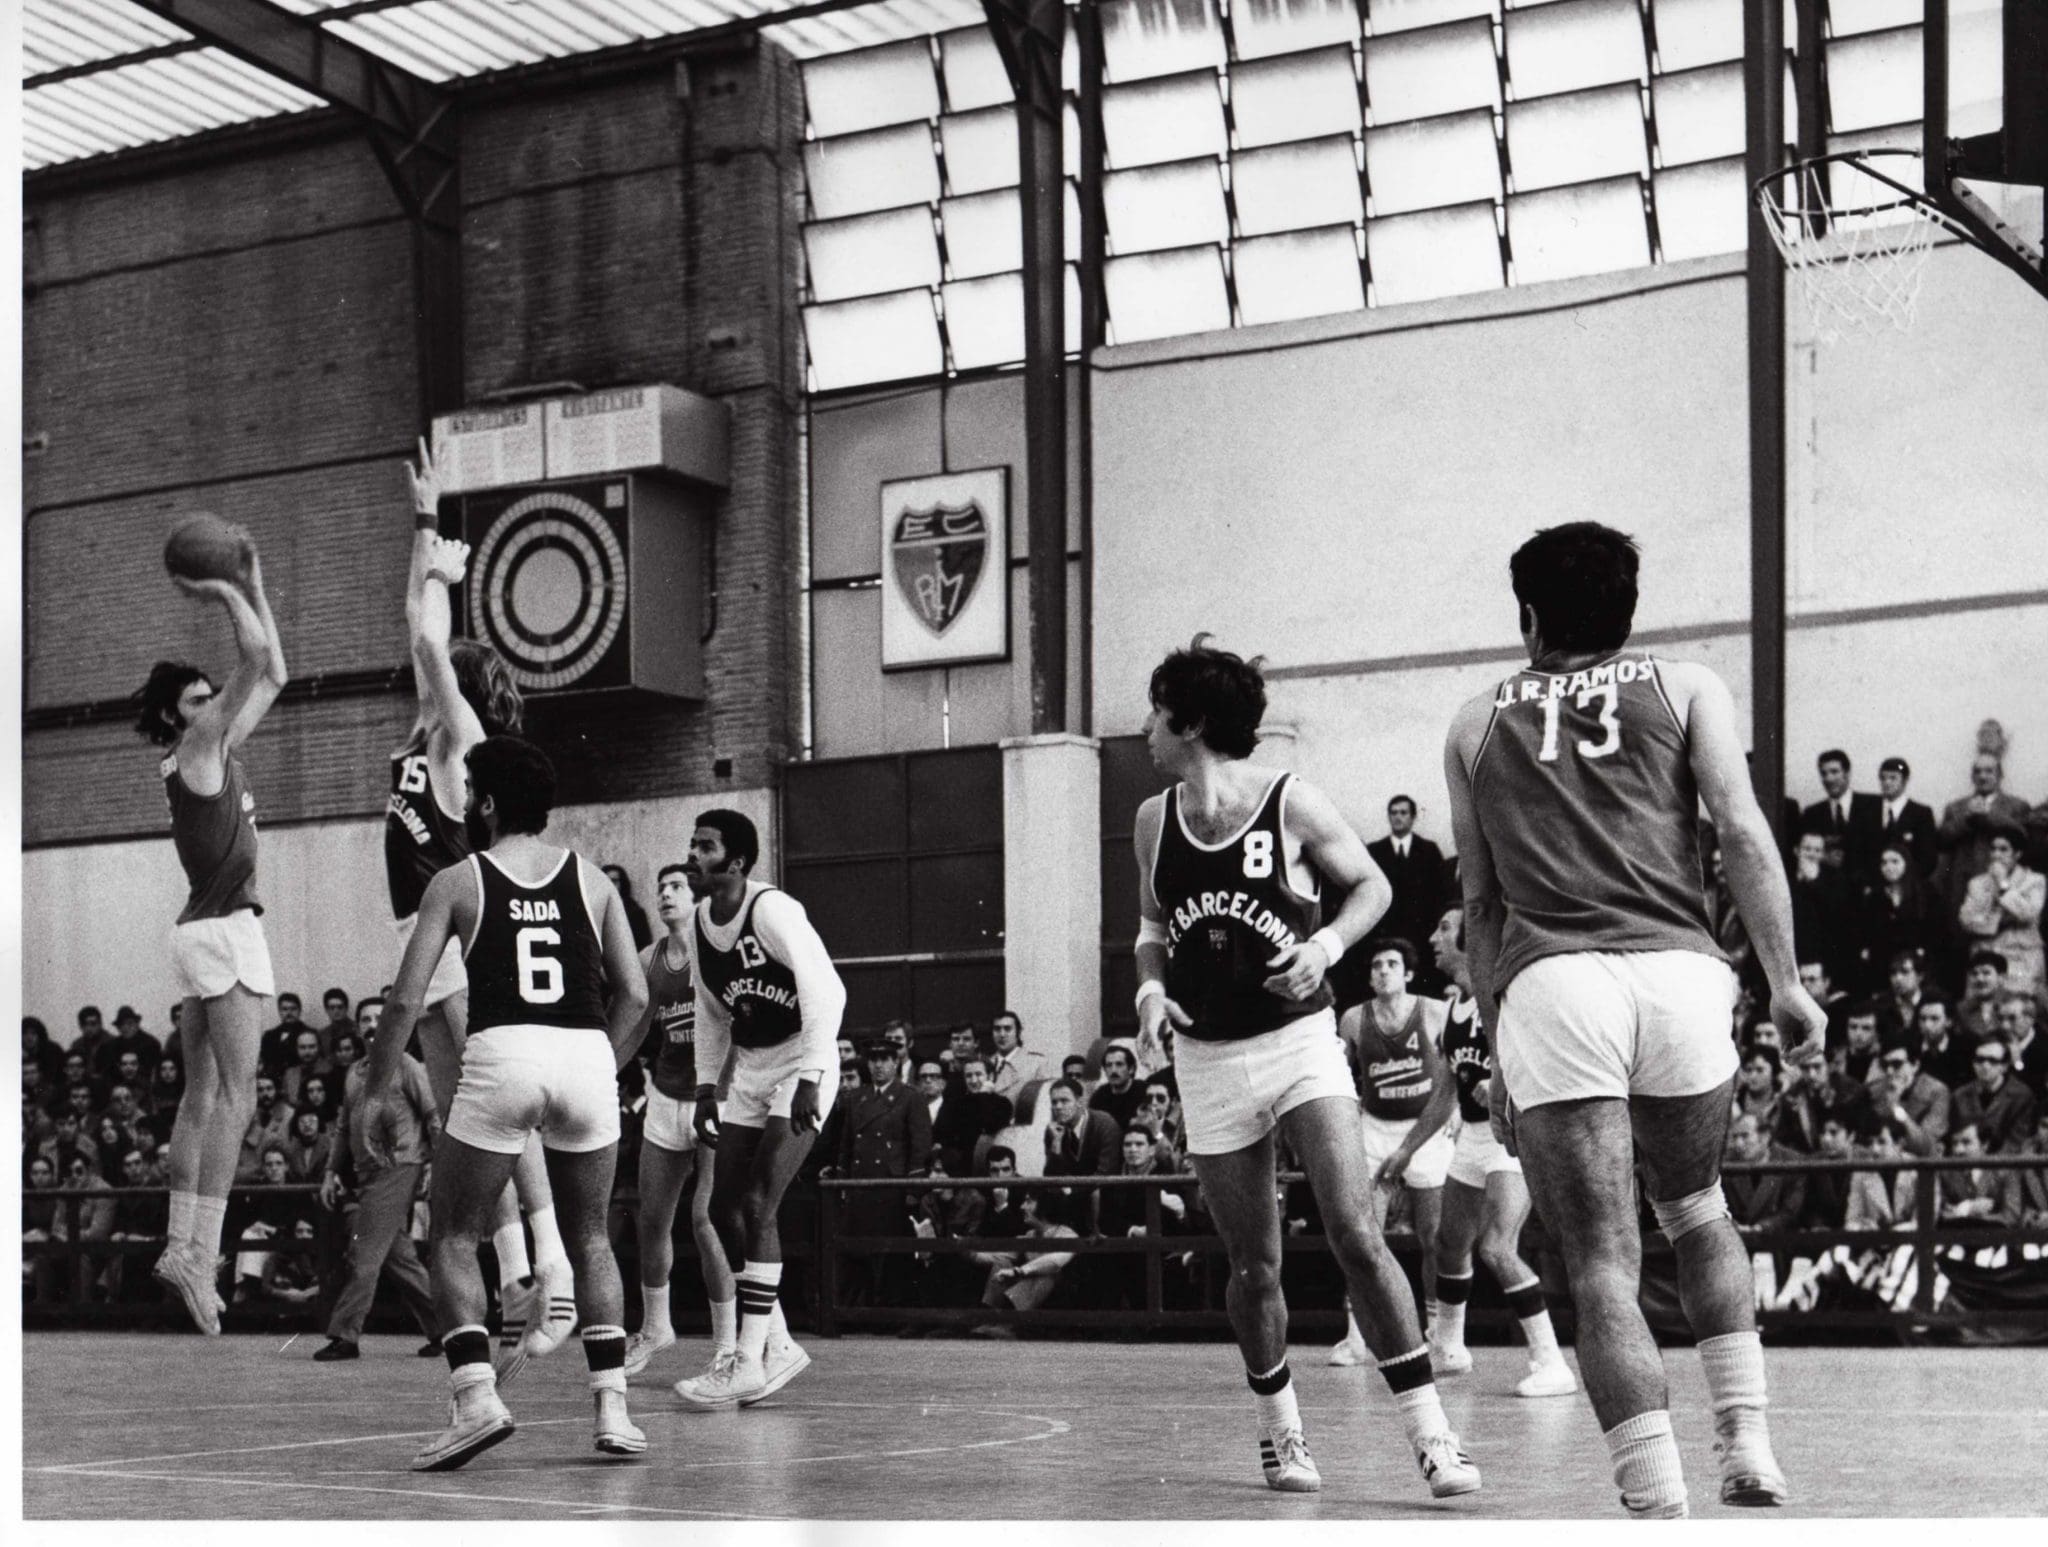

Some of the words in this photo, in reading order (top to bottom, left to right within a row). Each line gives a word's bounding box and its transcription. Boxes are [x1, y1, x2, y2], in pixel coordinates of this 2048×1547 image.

[1537, 684, 1621, 762] 13
[399, 756, 428, 793] 15
[1242, 830, 1273, 879] 8
[509, 899, 561, 922] SADA
[1175, 890, 1296, 950] BARCELONA
[516, 927, 565, 1004] 6
[735, 935, 767, 969] 13
[722, 978, 798, 1010] BARCELONA
[1405, 1031, 1420, 1051] 4
